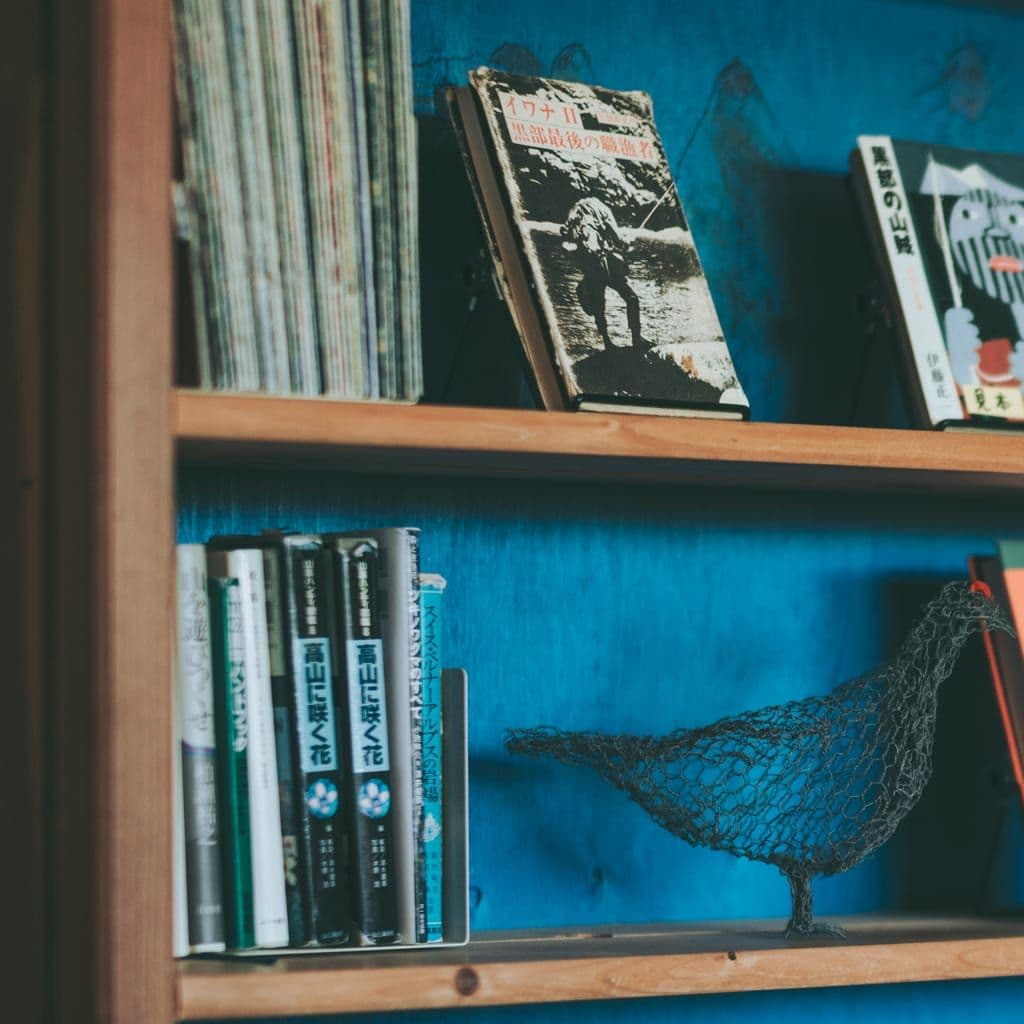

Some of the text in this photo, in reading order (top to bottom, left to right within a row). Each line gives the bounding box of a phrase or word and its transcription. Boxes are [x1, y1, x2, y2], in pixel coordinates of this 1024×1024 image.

[506, 96, 555, 121] イワナ
[303, 642, 333, 767] 高山に咲く花
[356, 643, 384, 767] 高山に咲く花
